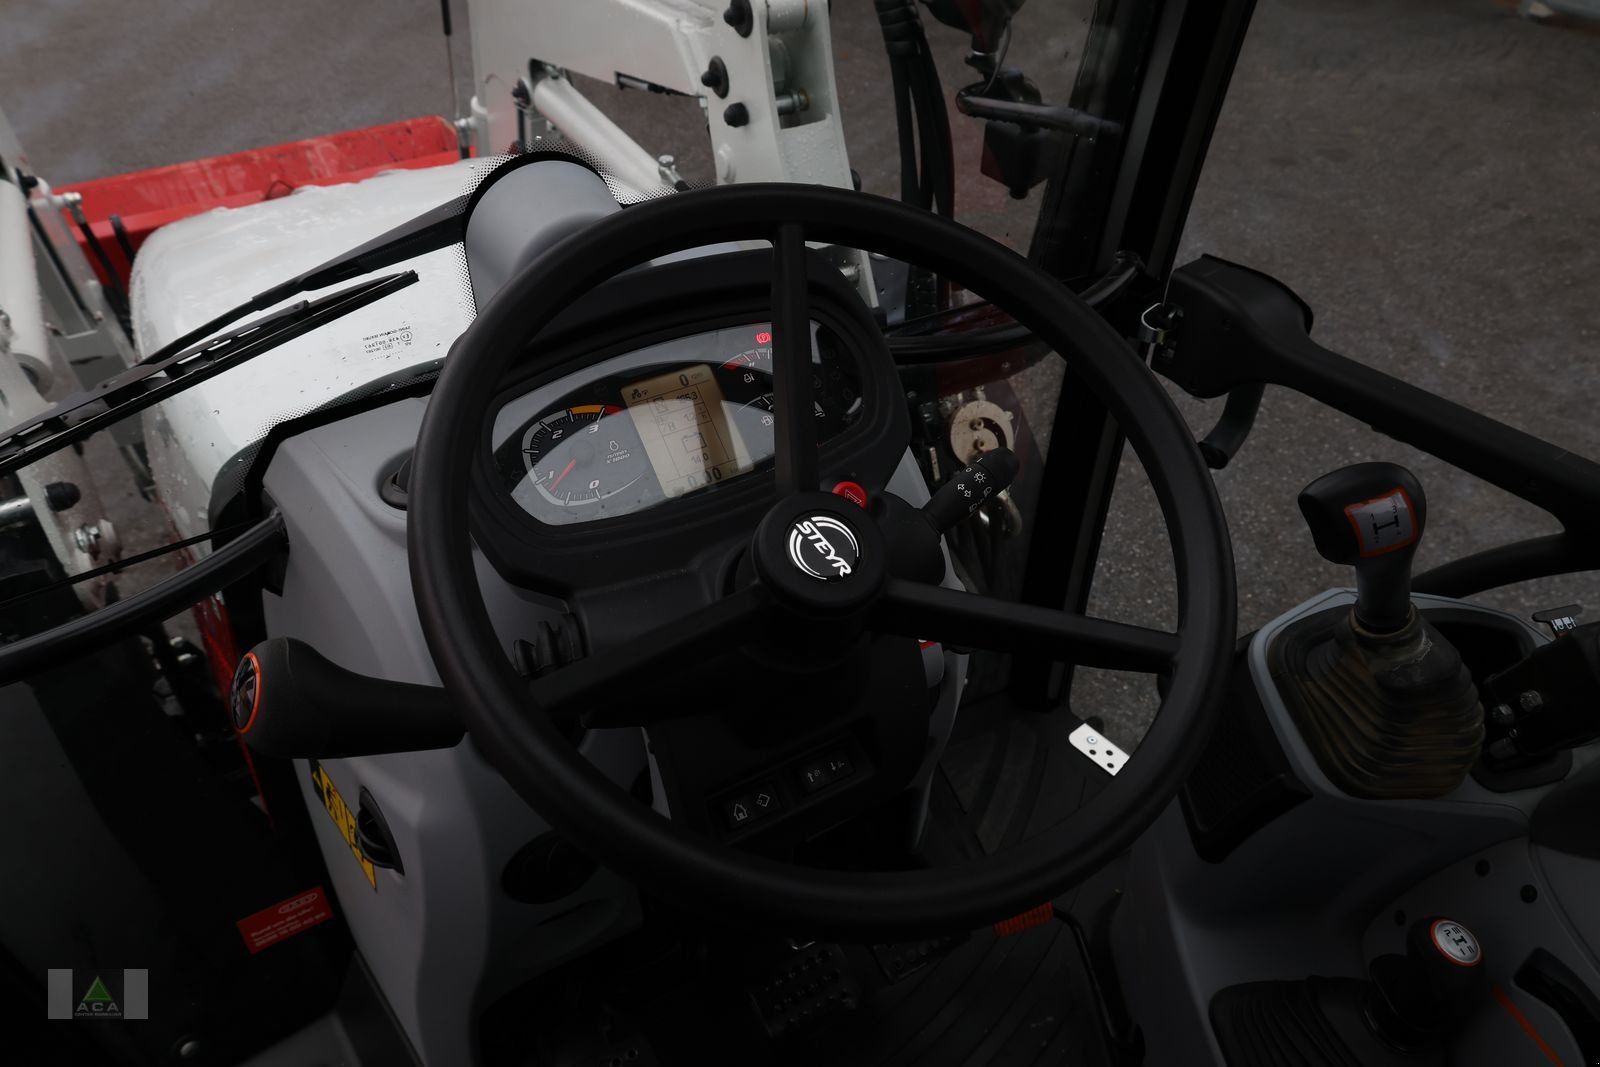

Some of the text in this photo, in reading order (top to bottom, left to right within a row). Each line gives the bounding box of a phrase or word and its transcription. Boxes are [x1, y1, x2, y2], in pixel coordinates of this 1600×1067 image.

[551, 429, 563, 439] 2
[588, 424, 599, 434] 3
[548, 470, 555, 479] 1
[589, 479, 600, 489] 0
[795, 521, 852, 578] STEYR
